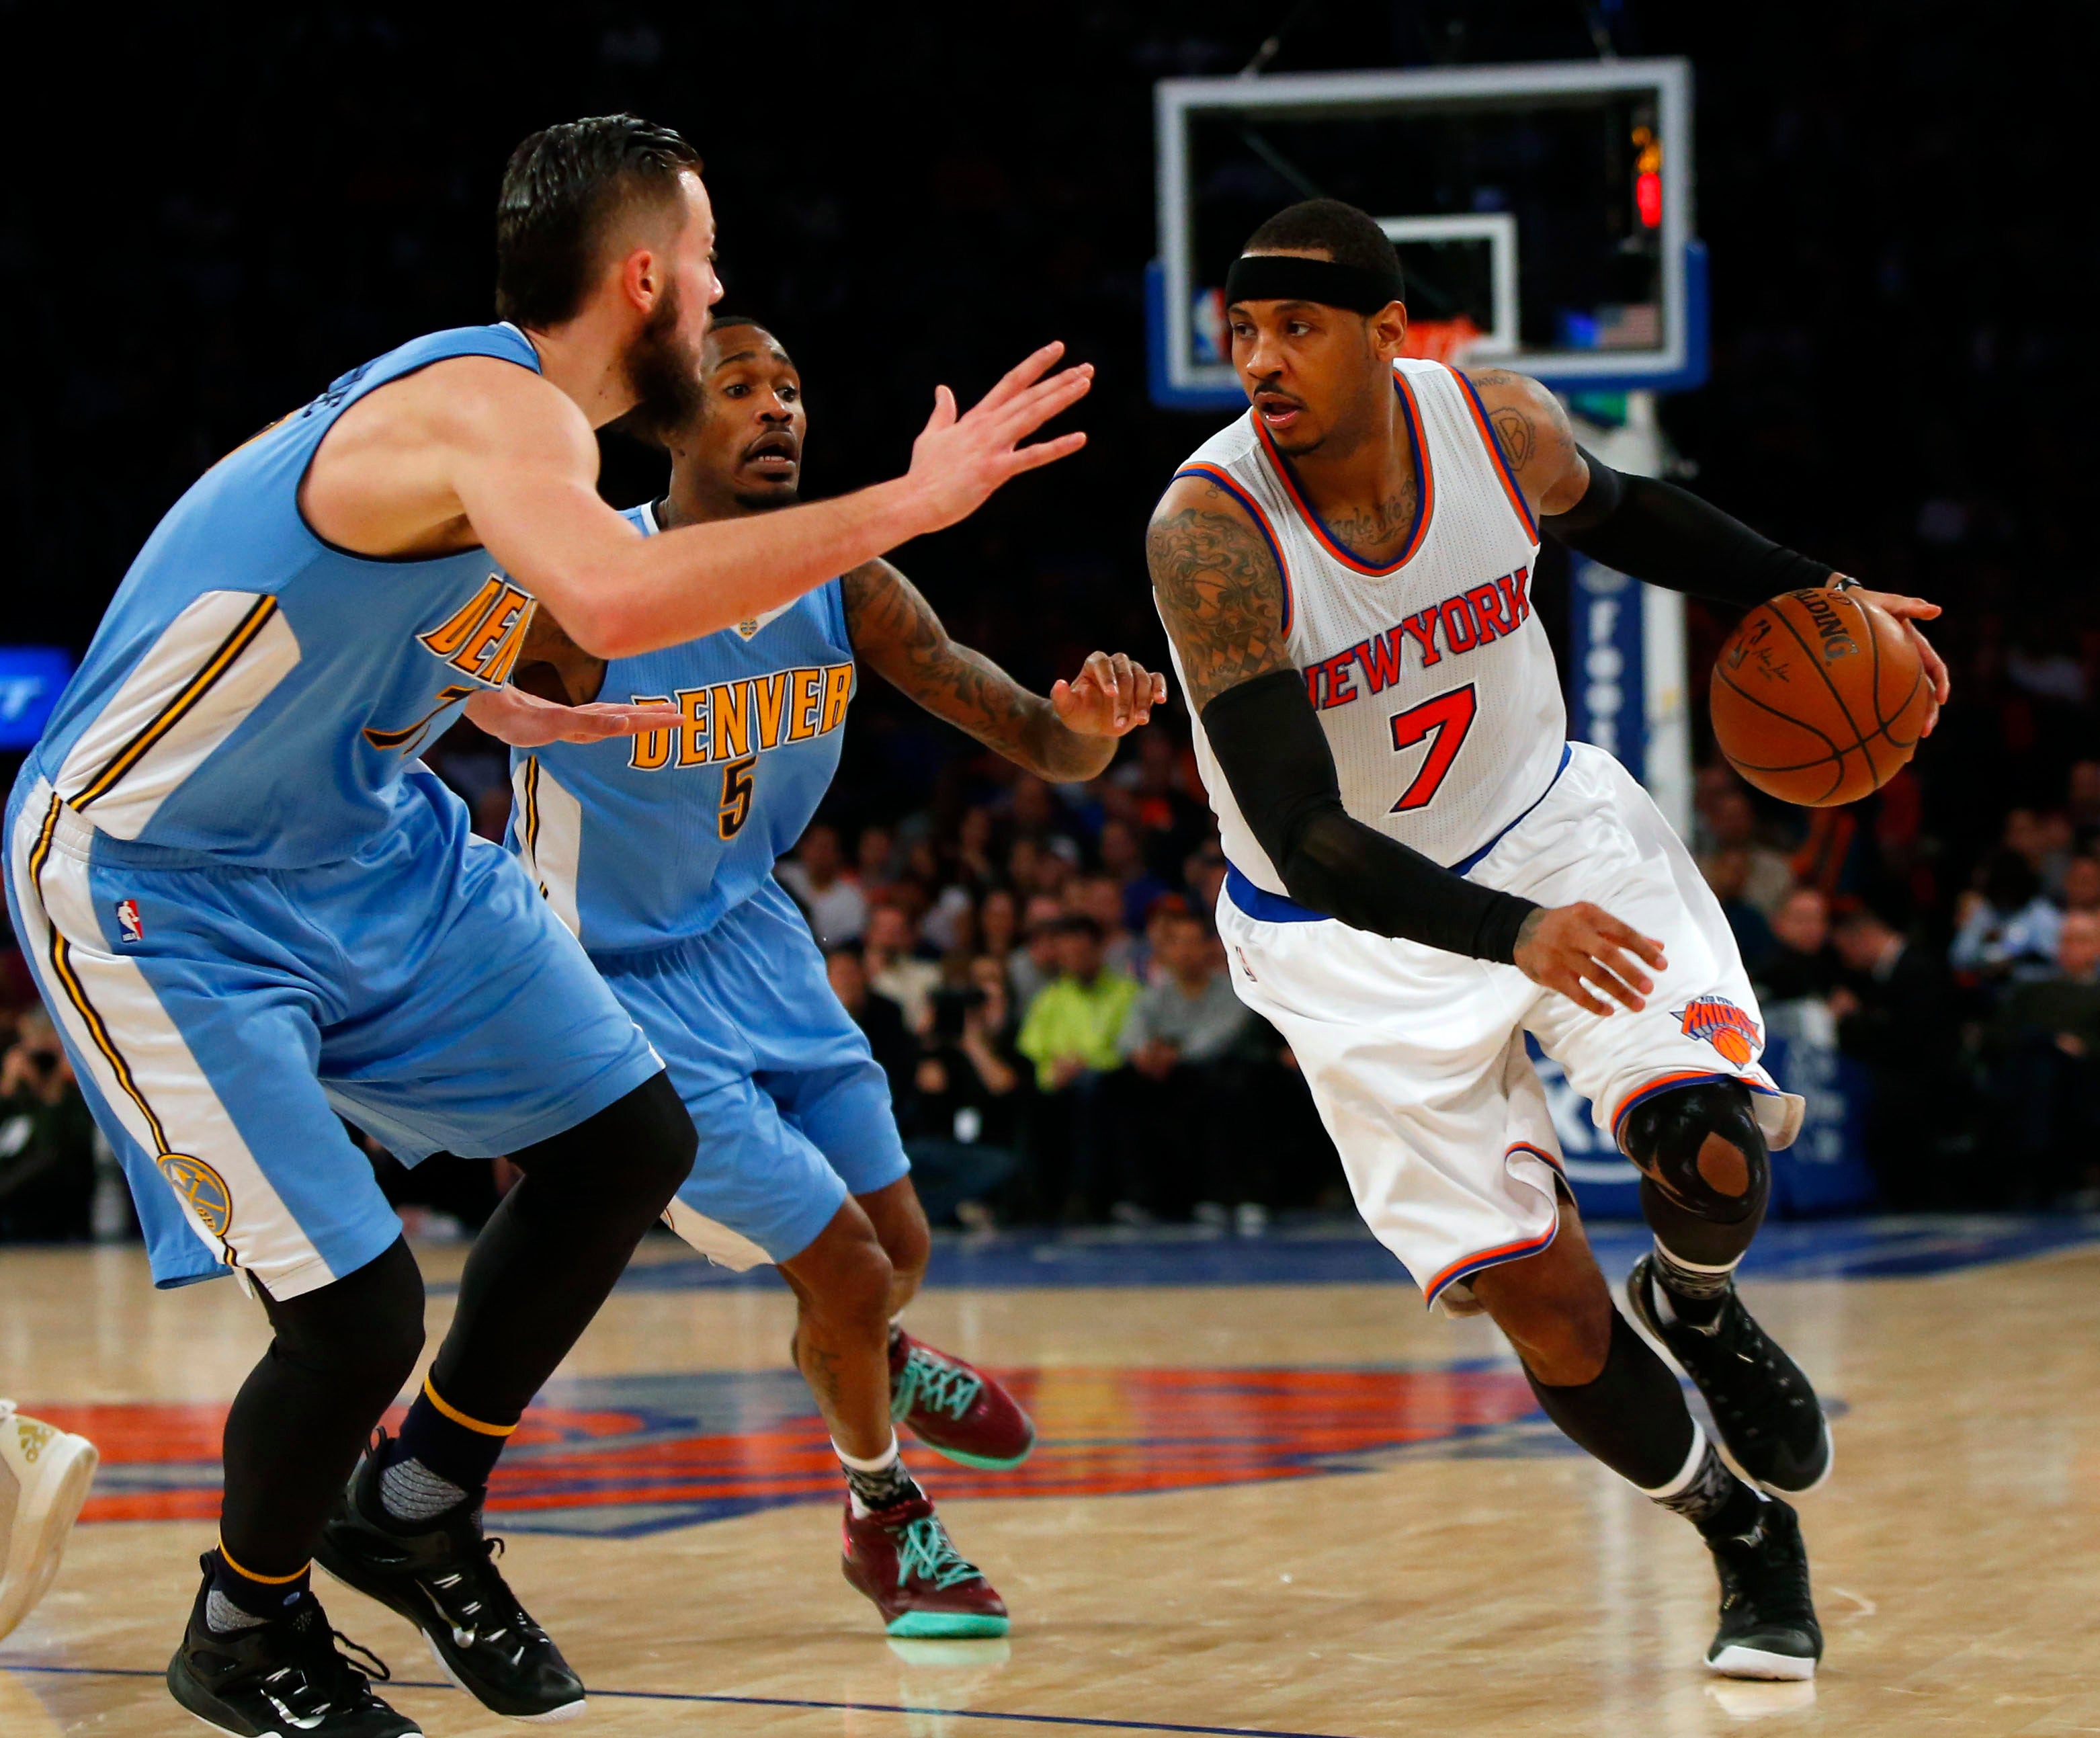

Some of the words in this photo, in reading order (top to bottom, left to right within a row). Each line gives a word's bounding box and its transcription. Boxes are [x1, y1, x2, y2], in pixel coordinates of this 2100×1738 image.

[627, 660, 855, 772] DENVER
[1388, 681, 1478, 814] 7
[717, 755, 759, 841] 5
[1681, 999, 1764, 1047] KNICKS
